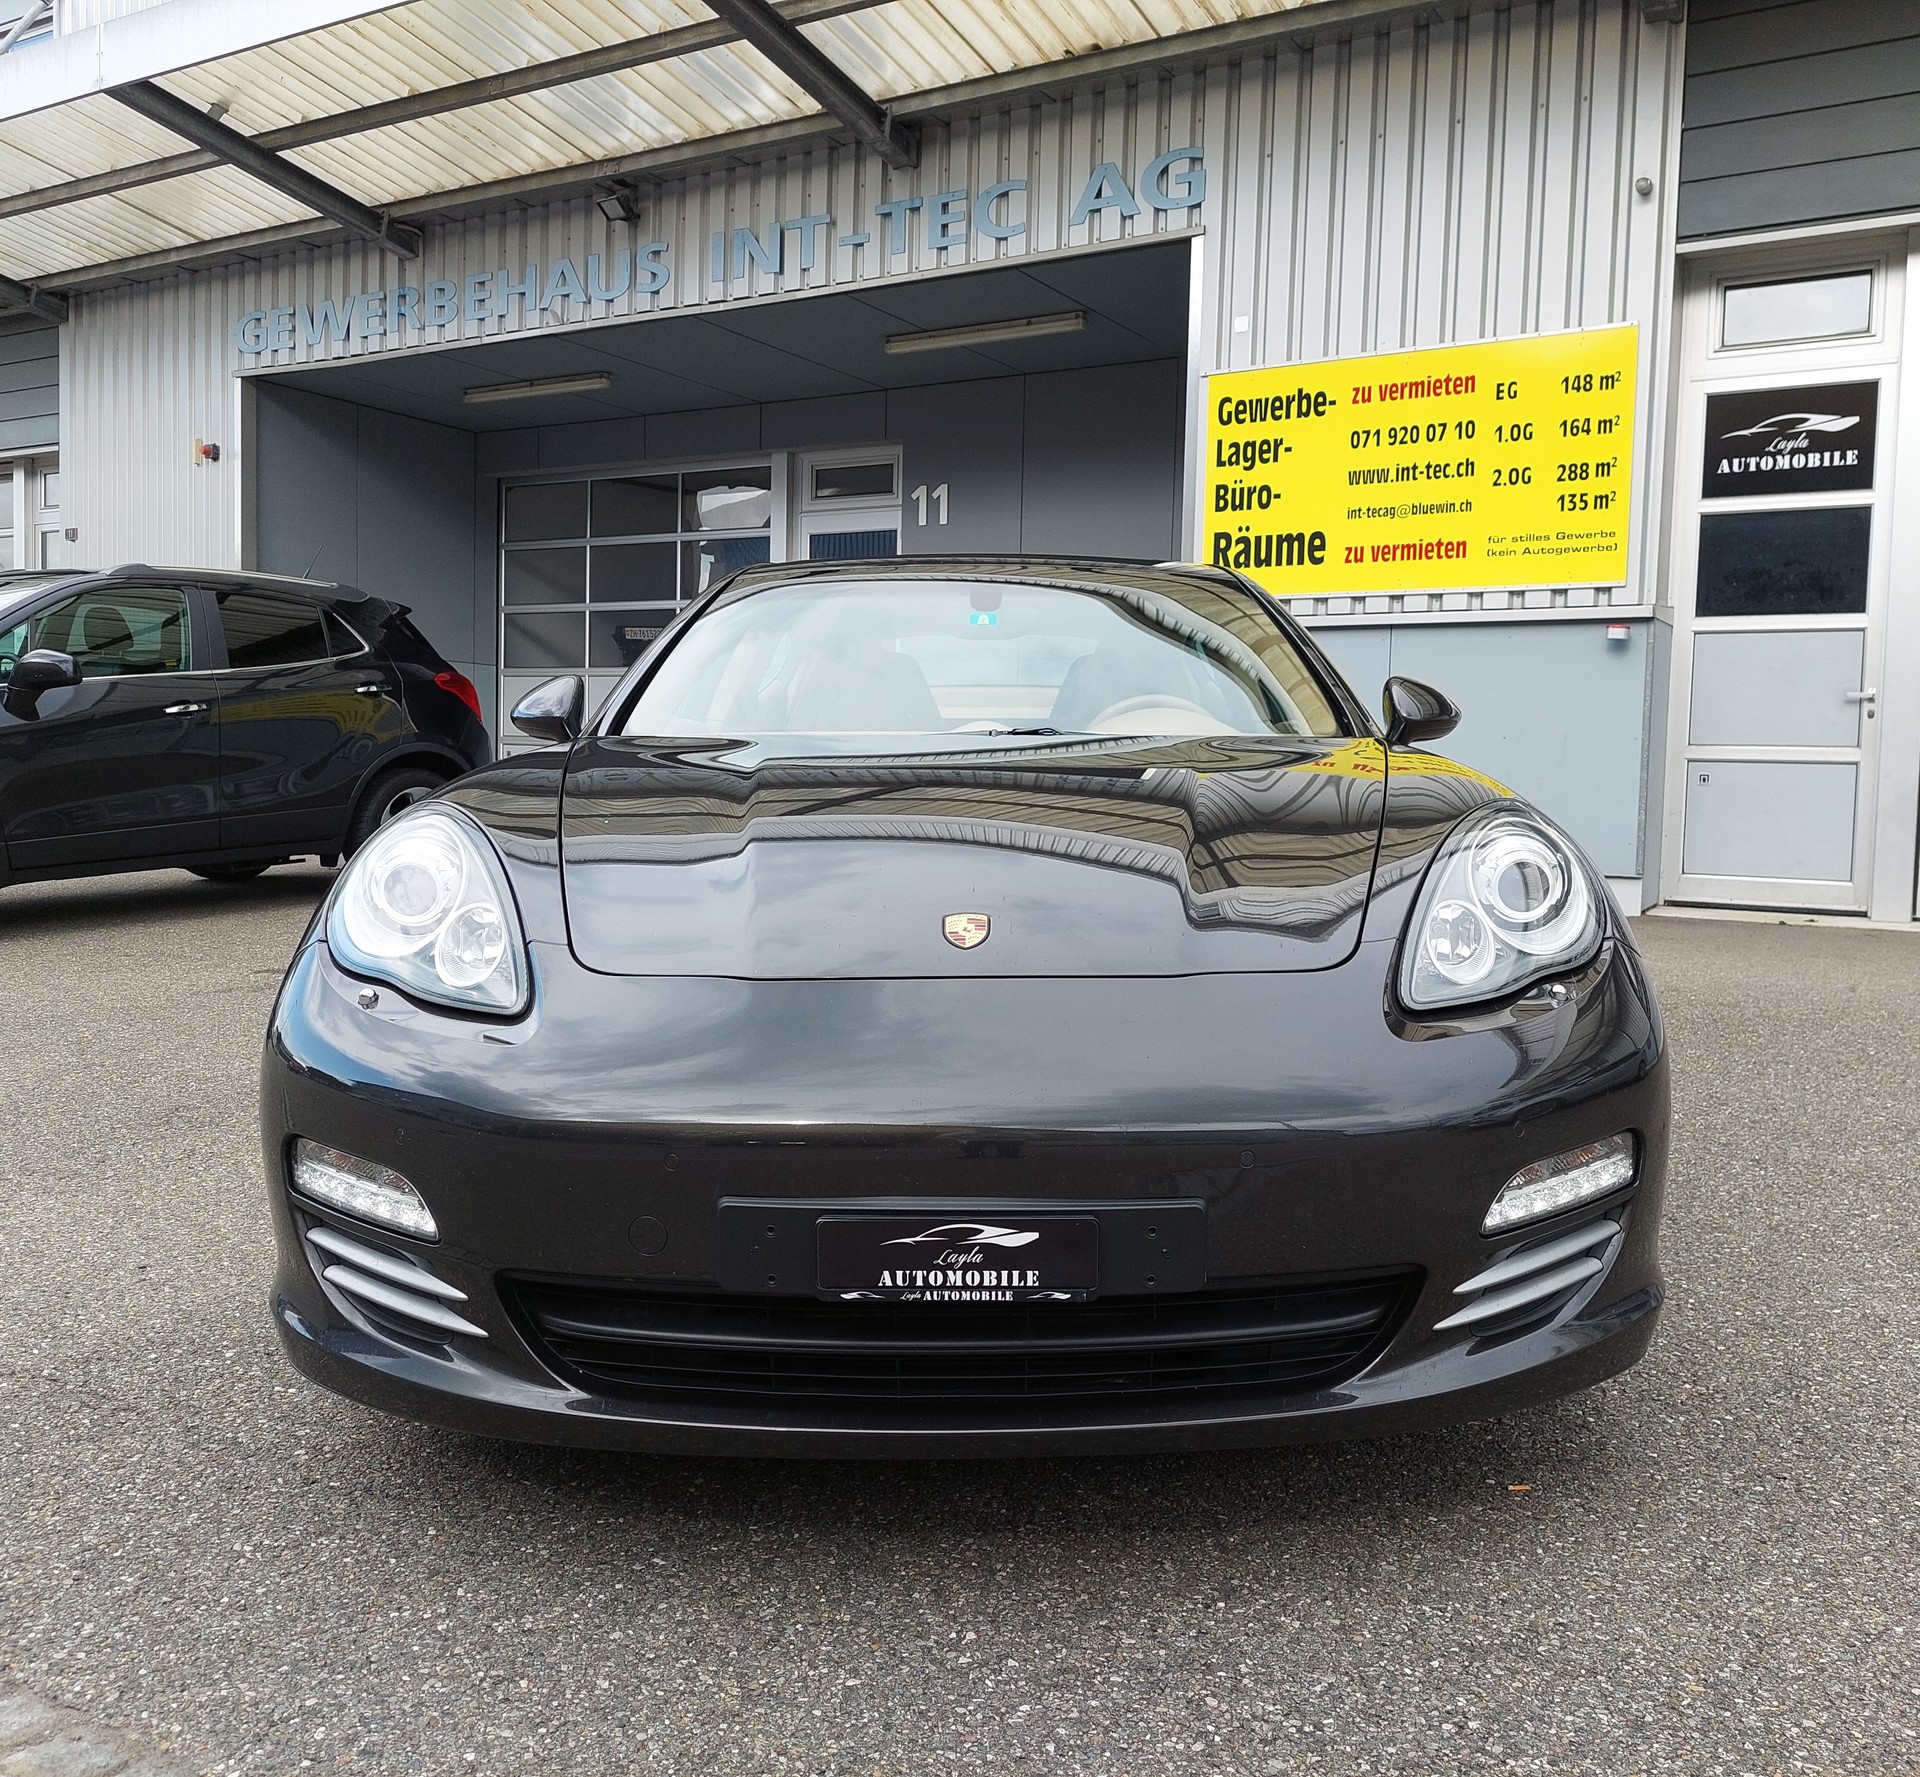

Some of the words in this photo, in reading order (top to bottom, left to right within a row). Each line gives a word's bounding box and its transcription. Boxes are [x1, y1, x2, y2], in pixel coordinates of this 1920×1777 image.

[234, 241, 671, 354] GEWERBEHAUS
[711, 178, 1028, 283] INT-TEC
[1068, 146, 1207, 227] AG
[1351, 385, 1373, 405] zu
[1378, 373, 1476, 402] vermieten
[1495, 381, 1518, 401] EG
[1561, 373, 1594, 395] 148
[1217, 387, 1337, 426] Gewerbe-
[1350, 428, 1381, 449] 071
[1388, 424, 1420, 446] 920
[1425, 422, 1448, 443] 07
[1454, 419, 1476, 440] 10
[1559, 417, 1592, 438] 164
[1216, 437, 1293, 472] Lager-
[1764, 432, 1810, 455] Layla
[1347, 457, 1476, 486] www.int-tec.ch
[1556, 462, 1590, 482] 288
[1717, 449, 1858, 474] AUTOMOBILE
[910, 483, 949, 526] 11
[1214, 478, 1282, 513] Büro-
[1556, 492, 1589, 512] 135
[1347, 499, 1472, 520] int-tecag@bluewin.ch
[1213, 525, 1327, 569] Räume
[1486, 547, 1517, 557] (kein
[1521, 542, 1618, 556] Autogewerbe)
[1487, 535, 1507, 544] für
[1511, 533, 1551, 543] stilles
[1555, 530, 1617, 541] Gewerbe
[1344, 545, 1365, 564] zu
[1371, 537, 1467, 562] vermieten
[932, 1245, 984, 1269] Layla
[878, 1270, 1040, 1287] AUTOMOBILE
[900, 1290, 922, 1301] Layla
[923, 1290, 1014, 1301] AUTOMOBILE
